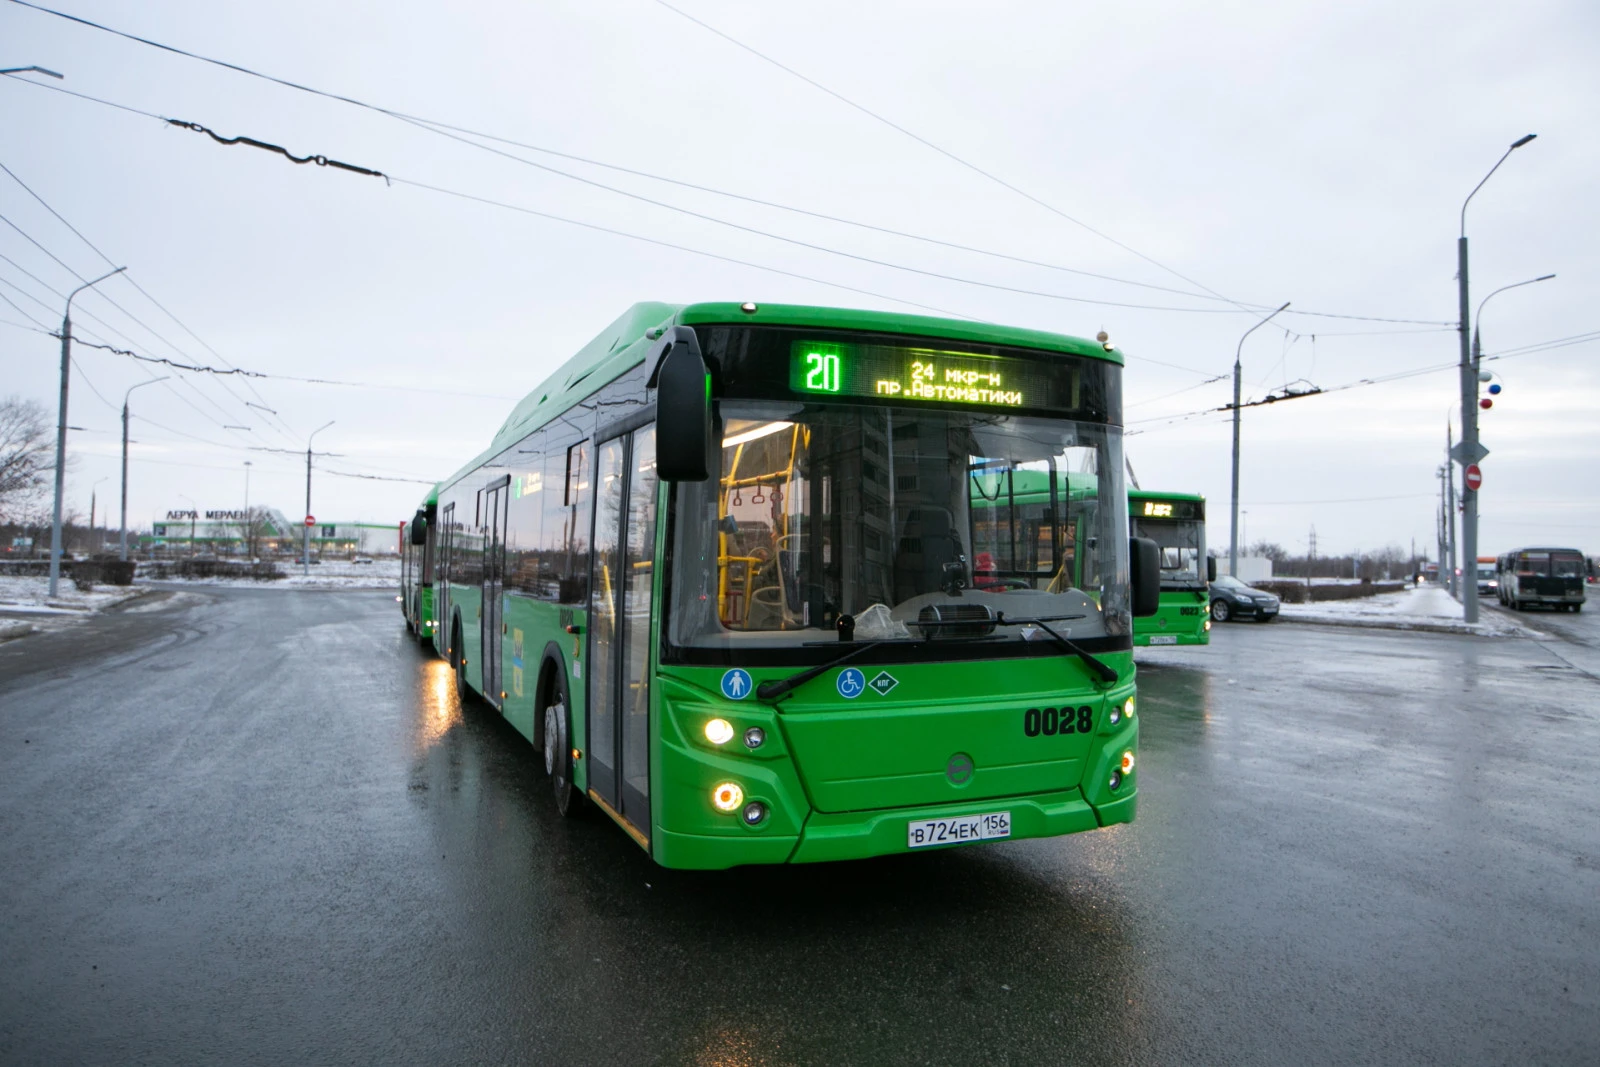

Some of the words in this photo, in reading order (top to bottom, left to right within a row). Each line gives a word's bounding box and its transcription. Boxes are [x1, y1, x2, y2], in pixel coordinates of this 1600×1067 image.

[806, 353, 840, 391] 20
[911, 361, 934, 380] 24
[945, 368, 1001, 386] мкр-н
[167, 511, 199, 520] ЛЕРУА
[1024, 705, 1093, 737] 0028
[915, 822, 979, 843] В724ЕК
[983, 814, 1006, 830] 156
